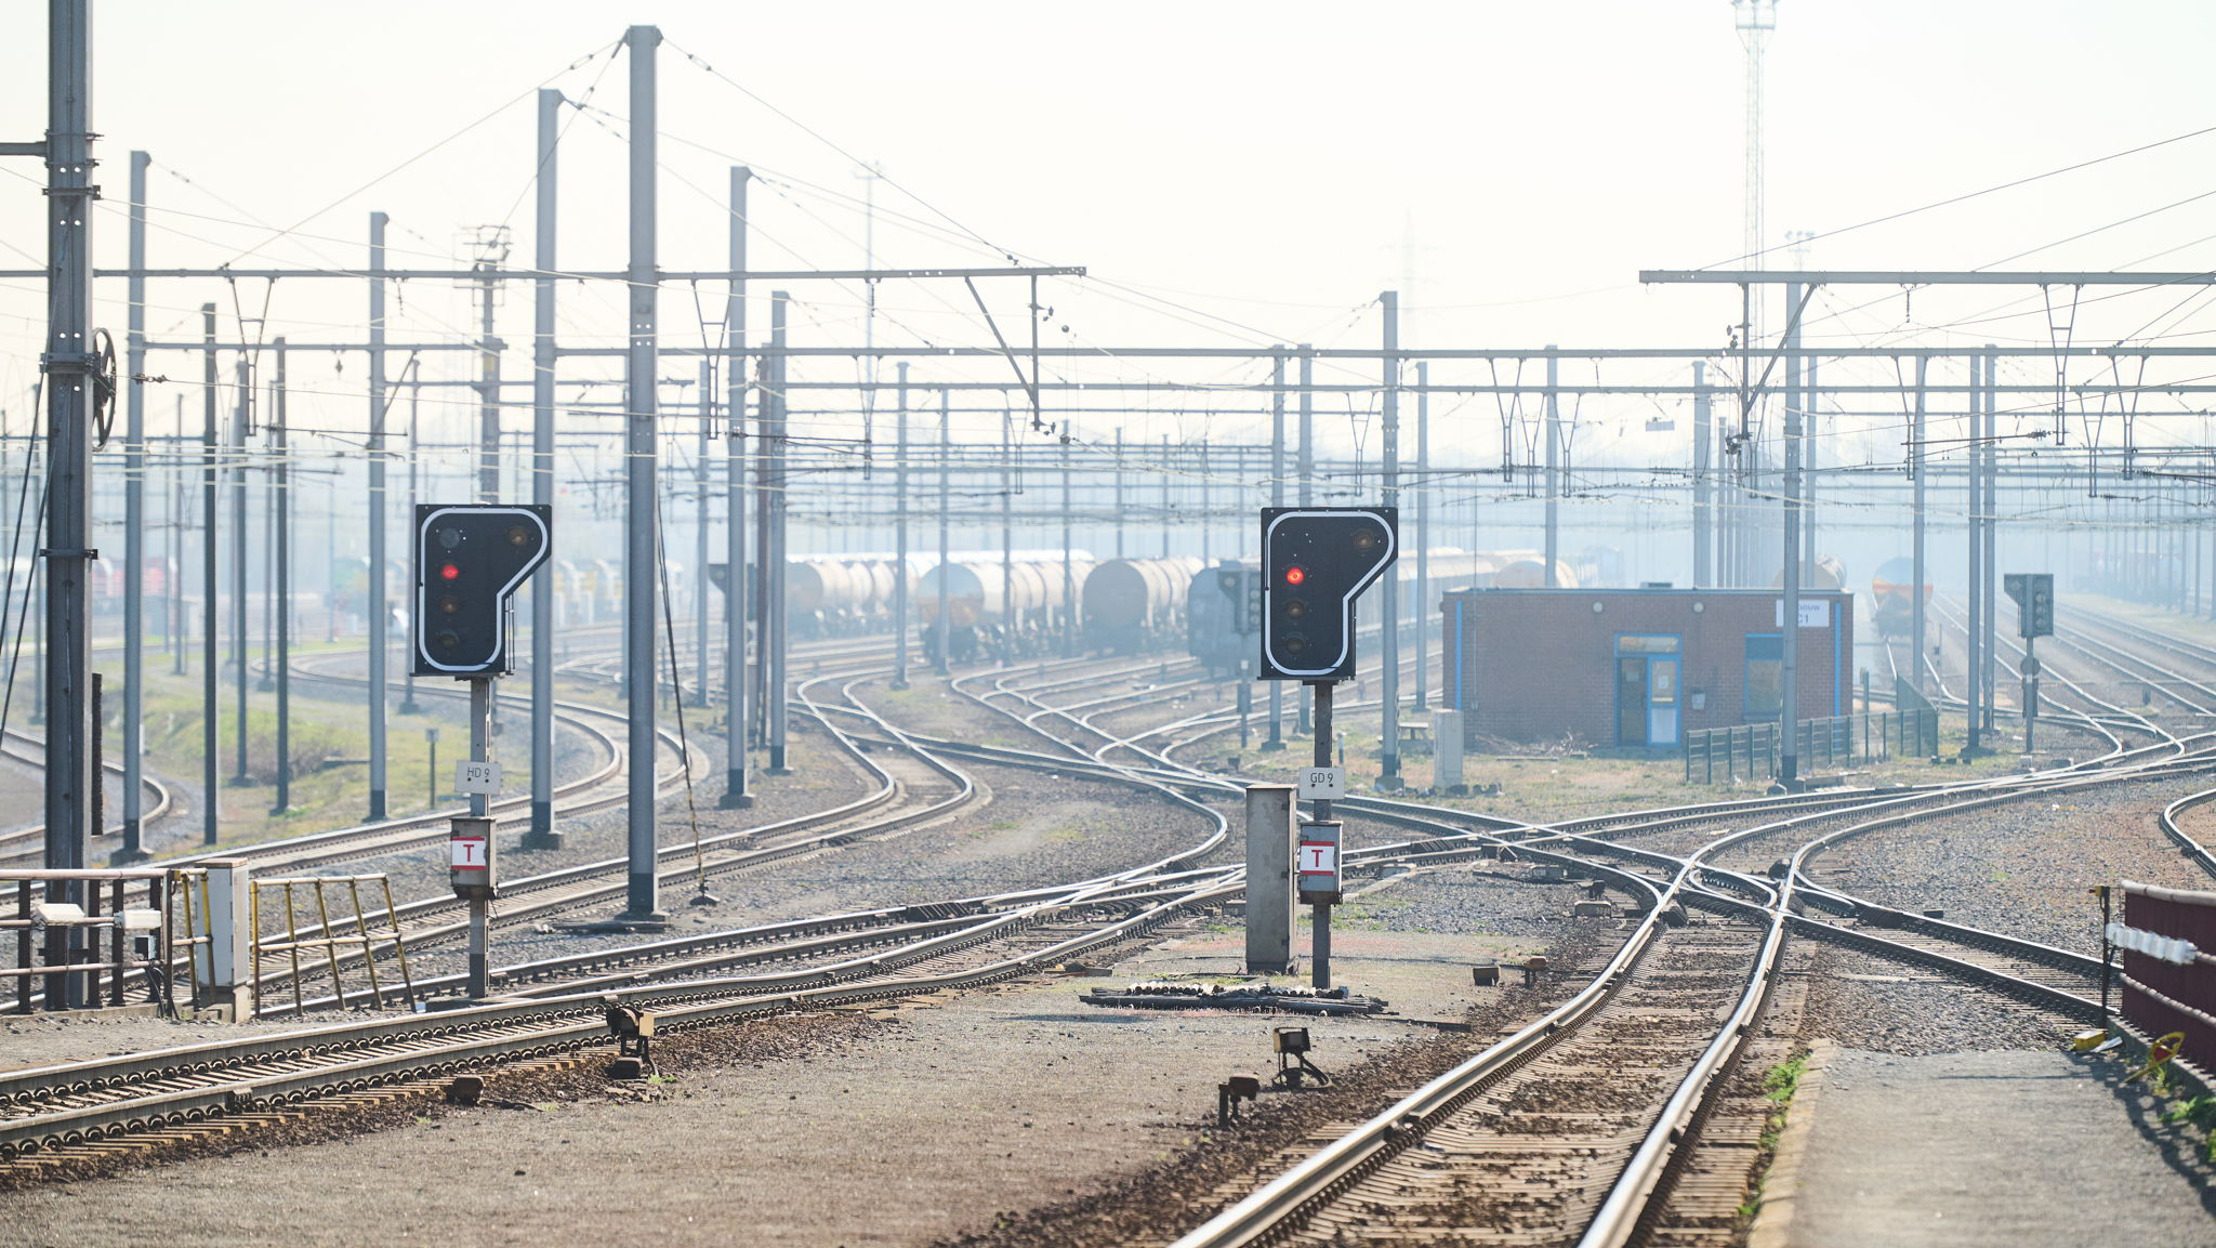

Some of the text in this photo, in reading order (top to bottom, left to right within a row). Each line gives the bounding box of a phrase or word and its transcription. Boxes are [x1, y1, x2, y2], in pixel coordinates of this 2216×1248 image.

[467, 767, 481, 778] HD
[1310, 772, 1333, 783] GD 9
[463, 844, 474, 862] T
[1311, 849, 1323, 867] T
